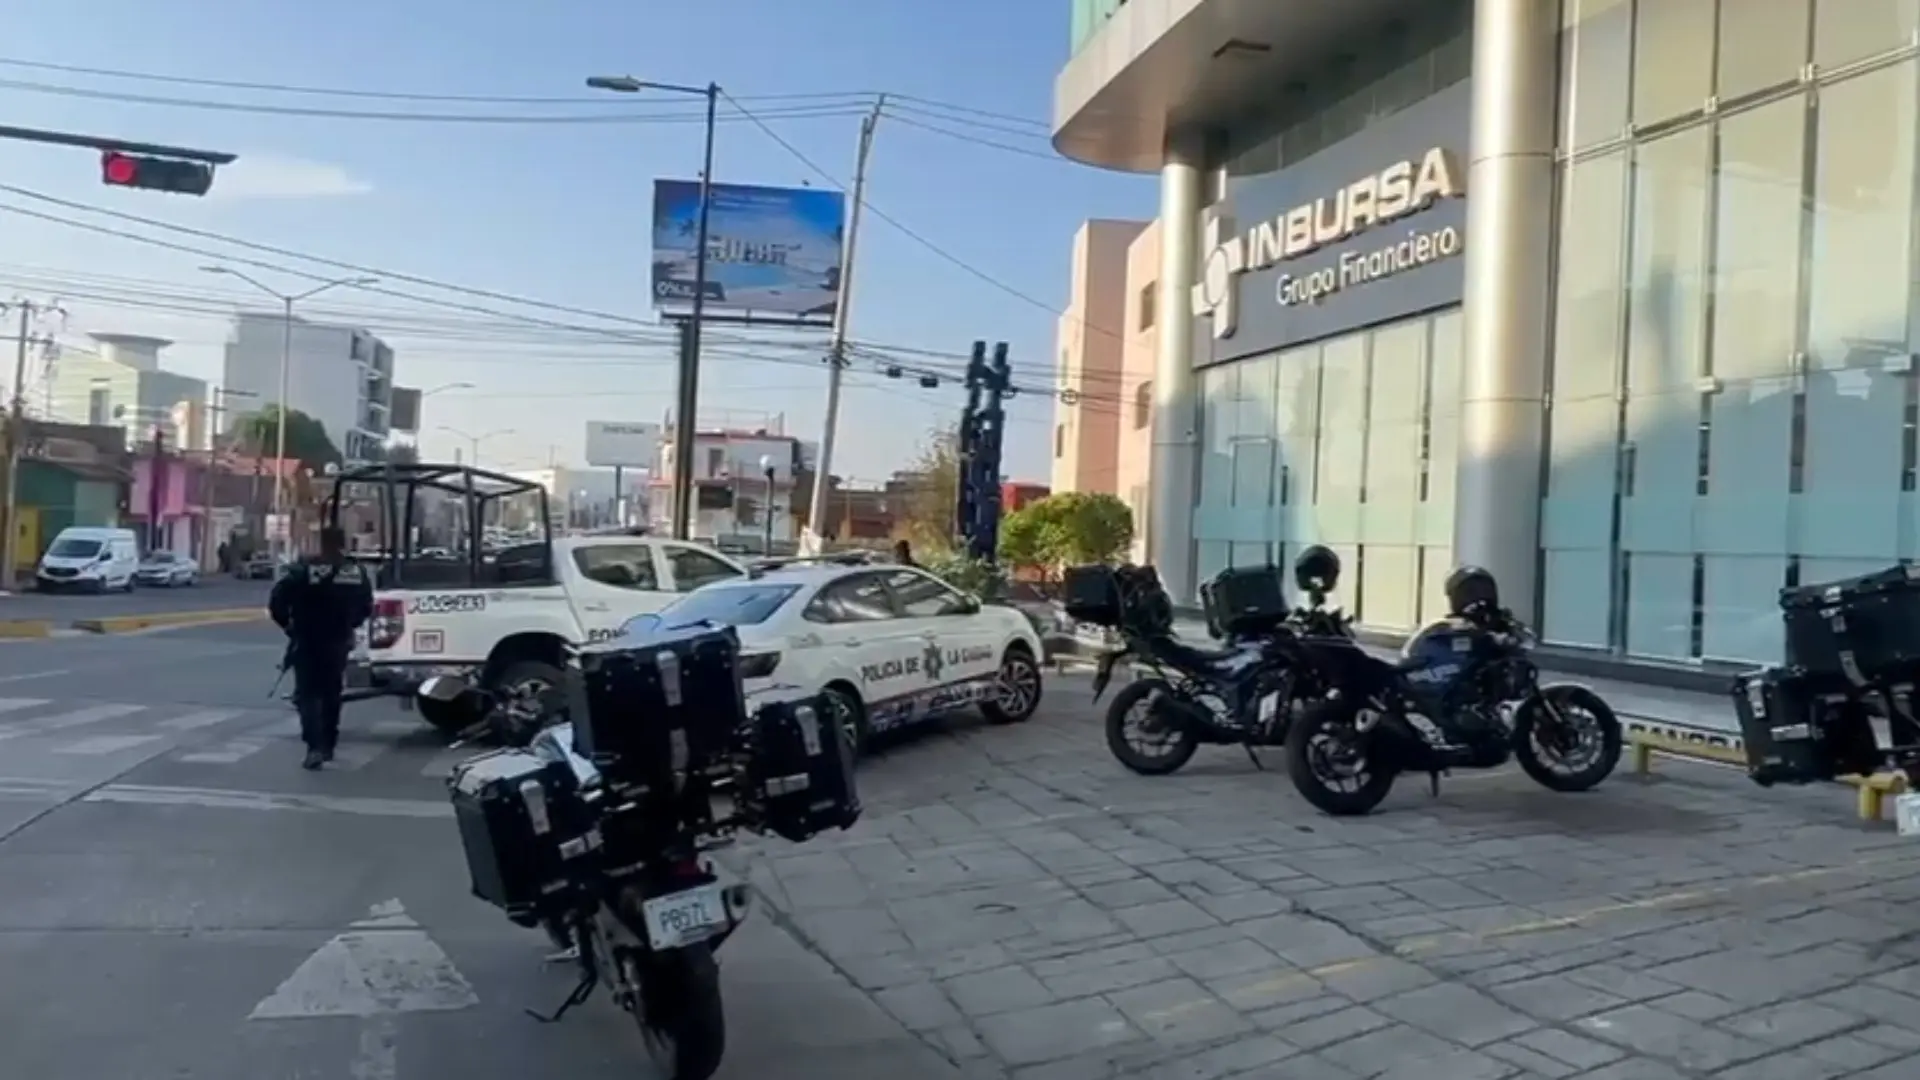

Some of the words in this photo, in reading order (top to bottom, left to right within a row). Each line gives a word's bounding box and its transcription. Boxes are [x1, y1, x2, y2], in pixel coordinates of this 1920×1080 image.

[1248, 147, 1453, 269] INBURSA
[1276, 264, 1335, 306] Grupo
[1339, 226, 1457, 286] Financiero
[905, 656, 921, 675] DE
